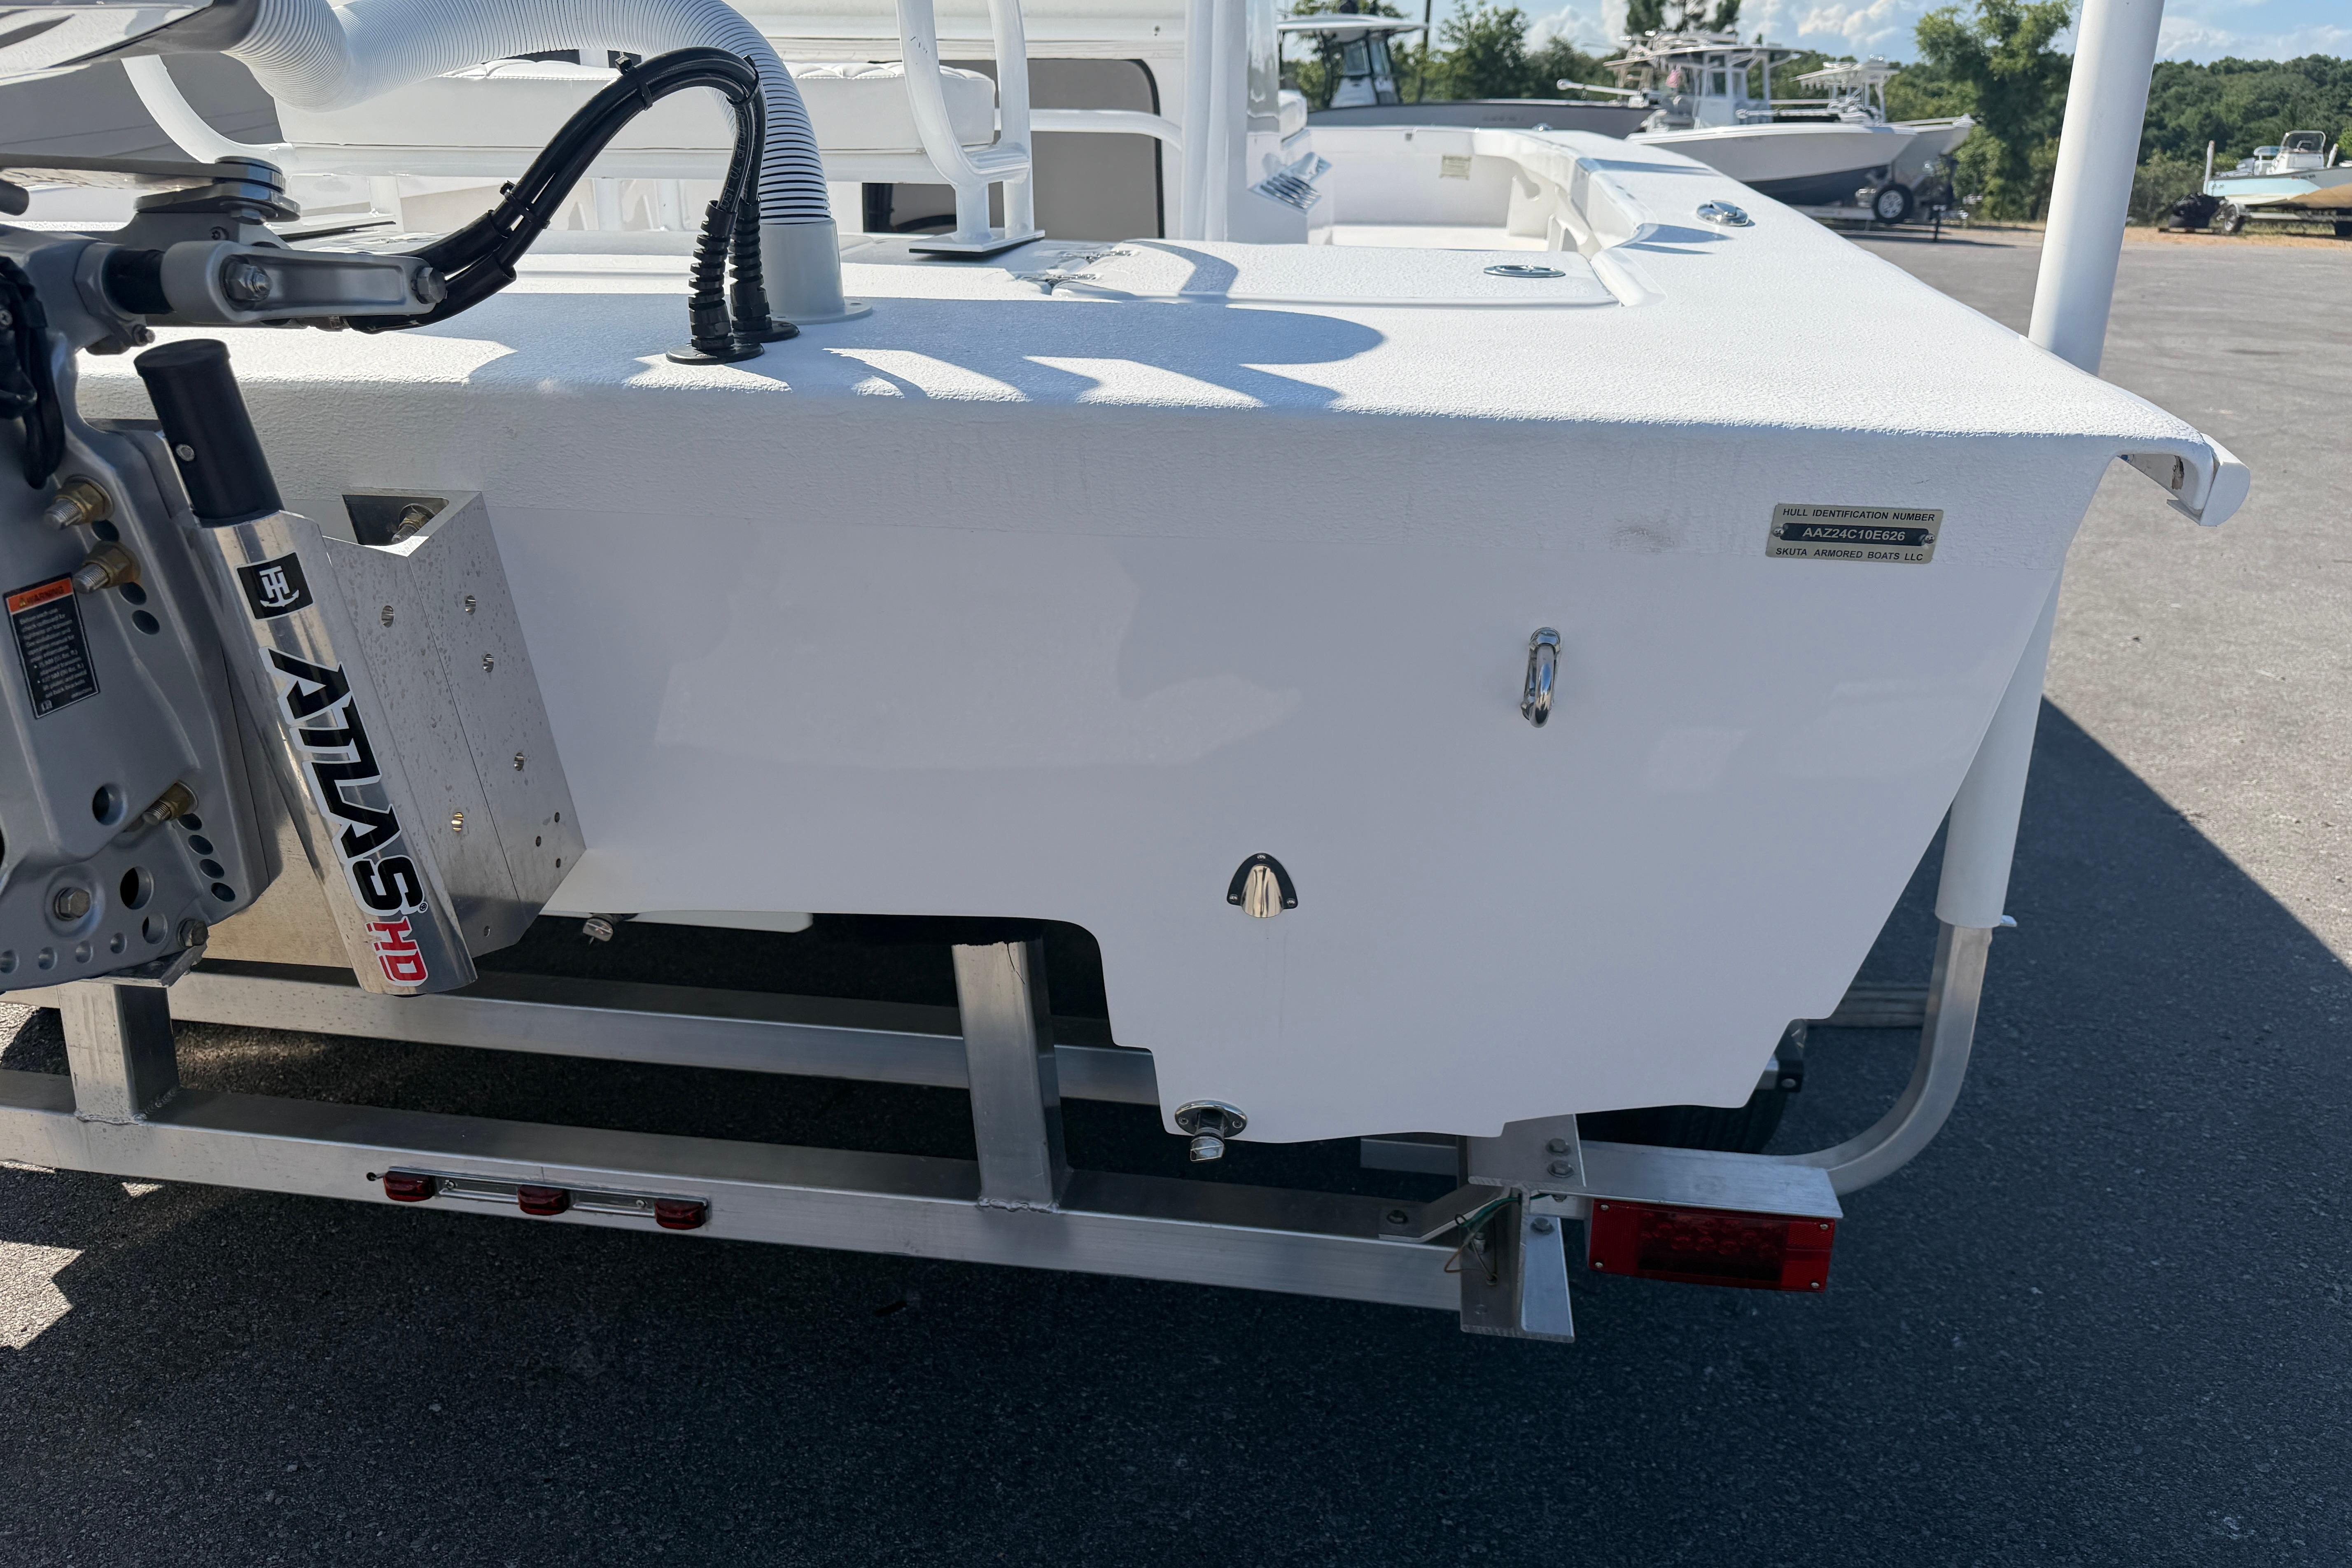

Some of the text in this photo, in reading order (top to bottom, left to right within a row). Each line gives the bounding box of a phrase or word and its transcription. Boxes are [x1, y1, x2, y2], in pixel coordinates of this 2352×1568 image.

[1813, 509, 1889, 520] IDENTIFICATION
[1893, 512, 1935, 522] NUMBER
[1802, 527, 1906, 541] AAZ24C10E626
[1776, 548, 1923, 561] SKUTA ARMORED BOATS LLC
[26, 586, 64, 604] WARNING
[366, 917, 427, 984] HD
